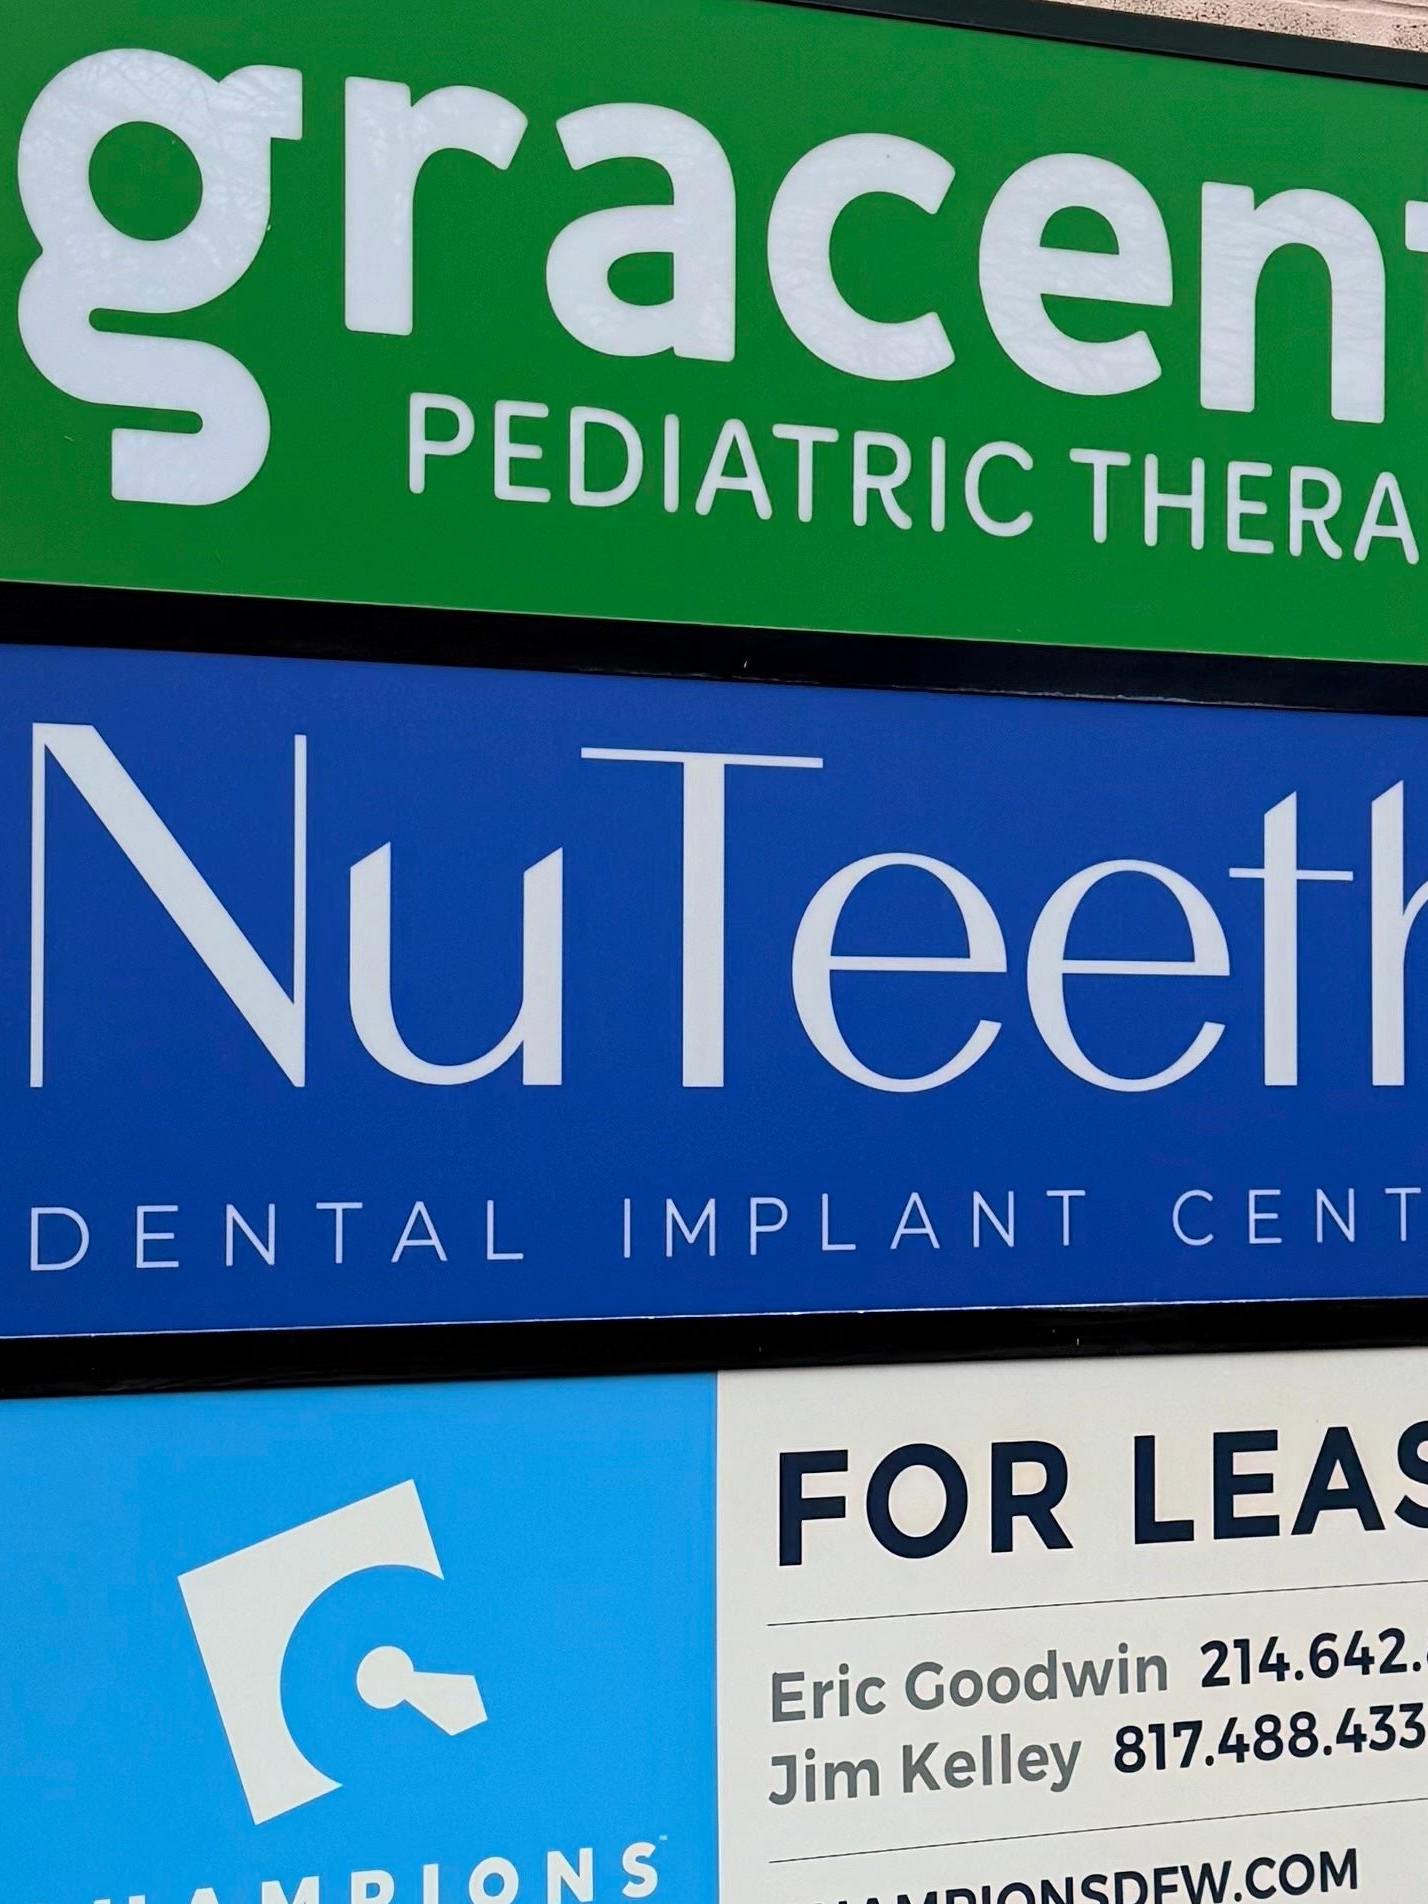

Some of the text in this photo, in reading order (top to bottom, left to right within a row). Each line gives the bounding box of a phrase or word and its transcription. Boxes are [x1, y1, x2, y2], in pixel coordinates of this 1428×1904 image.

[409, 392, 1034, 543] PEDIATRIC
[30, 1200, 524, 1271] DENTAL
[624, 1189, 1086, 1258] IMPLANT
[778, 1440, 1074, 1567] FOR
[771, 1662, 886, 1723] Eric
[905, 1642, 1168, 1711] Goodwin
[768, 1747, 880, 1806] Jim
[902, 1733, 1082, 1794] Kelley
